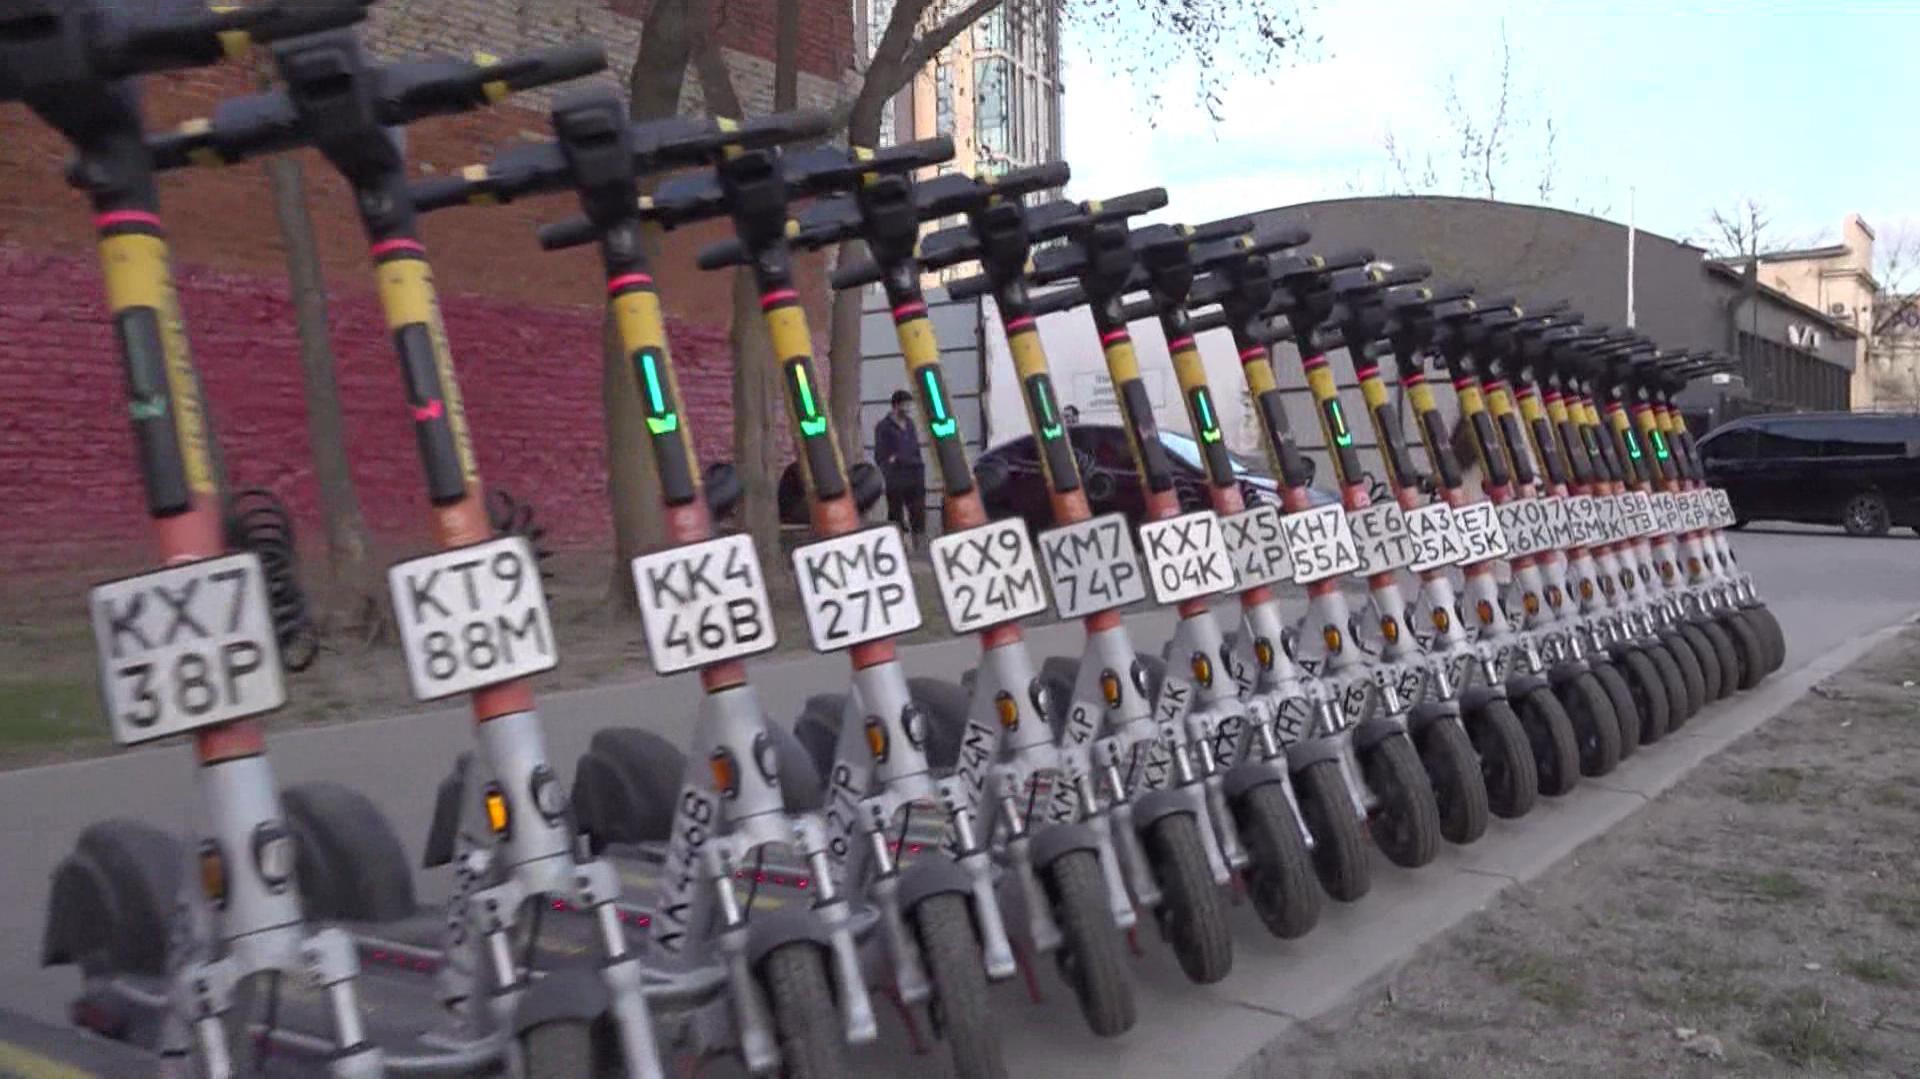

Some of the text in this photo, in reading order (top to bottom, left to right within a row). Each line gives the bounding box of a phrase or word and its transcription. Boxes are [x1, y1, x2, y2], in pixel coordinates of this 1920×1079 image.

[1046, 521, 1121, 573] KM7
[1147, 518, 1213, 560] KX7
[1285, 510, 1339, 547] KH7
[1406, 508, 1450, 537] KA3
[1509, 525, 1548, 552] 6K
[646, 545, 754, 609] KK4
[805, 536, 897, 594] KM6
[941, 528, 1022, 580] KX9
[1161, 551, 1223, 592] 04K
[1295, 541, 1354, 576] 55A
[103, 567, 249, 658] KX7
[406, 551, 525, 624] KT9
[819, 582, 905, 641] 27P
[955, 568, 1039, 622] 24M
[1057, 561, 1134, 612] 74P
[424, 606, 549, 680] 88M
[664, 597, 763, 657] 46B
[118, 639, 263, 728] 38P
